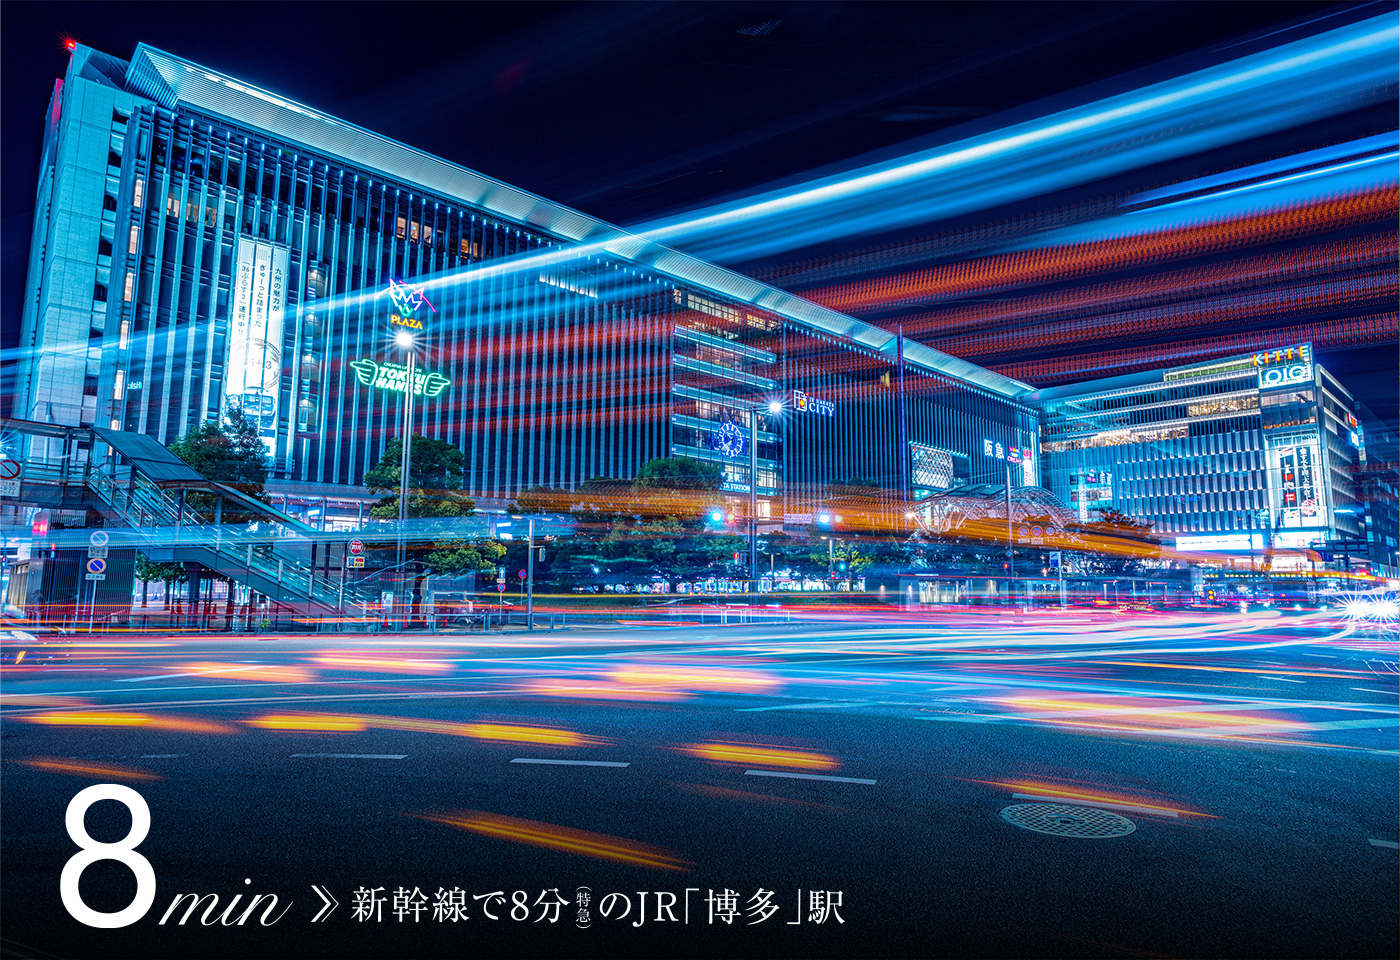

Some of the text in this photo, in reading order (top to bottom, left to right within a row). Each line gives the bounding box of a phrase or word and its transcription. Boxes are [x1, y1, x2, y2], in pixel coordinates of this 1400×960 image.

[272, 267, 283, 312] 九州の魅力が
[390, 314, 424, 330] PLAZA
[1252, 345, 1310, 366] KITTE
[379, 366, 426, 386] TOKU
[375, 378, 423, 395] HANS
[808, 402, 835, 417] CITY
[984, 439, 1004, 459] 阪急
